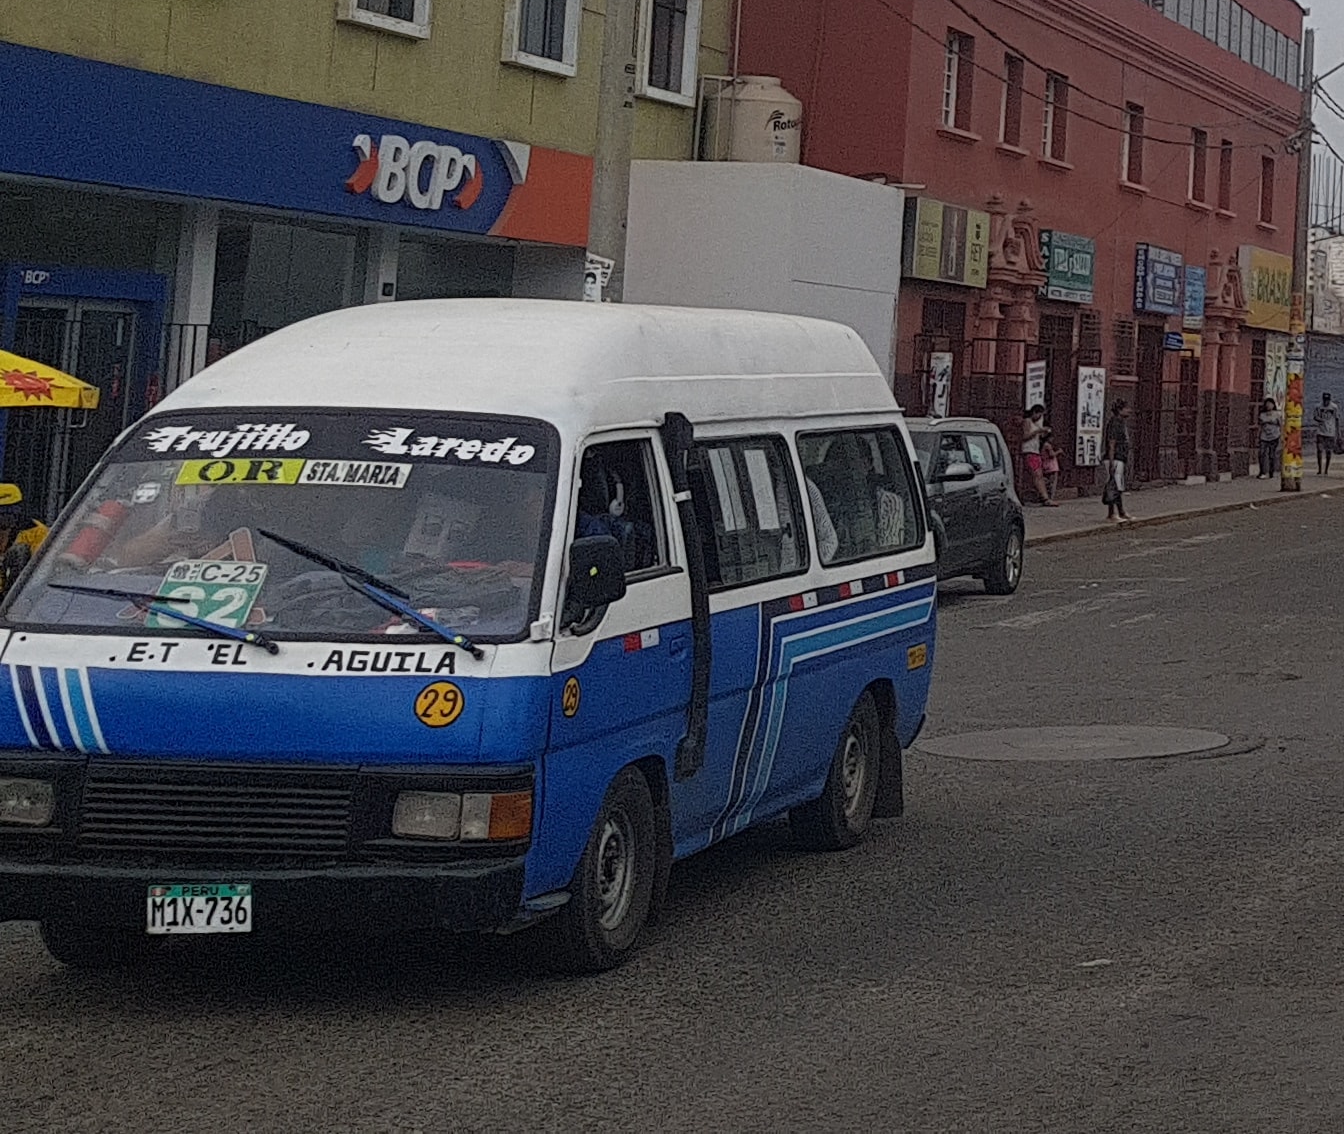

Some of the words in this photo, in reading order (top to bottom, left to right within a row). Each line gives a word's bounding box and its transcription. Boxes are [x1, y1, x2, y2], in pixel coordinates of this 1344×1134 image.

[371, 134, 464, 210] BCP
[143, 422, 311, 458] Trujillo
[361, 426, 536, 466] Laredo
[420, 688, 460, 719] 29
[563, 682, 578, 713] 29
[182, 886, 220, 896] PERU
[151, 896, 248, 927] M1X-736
